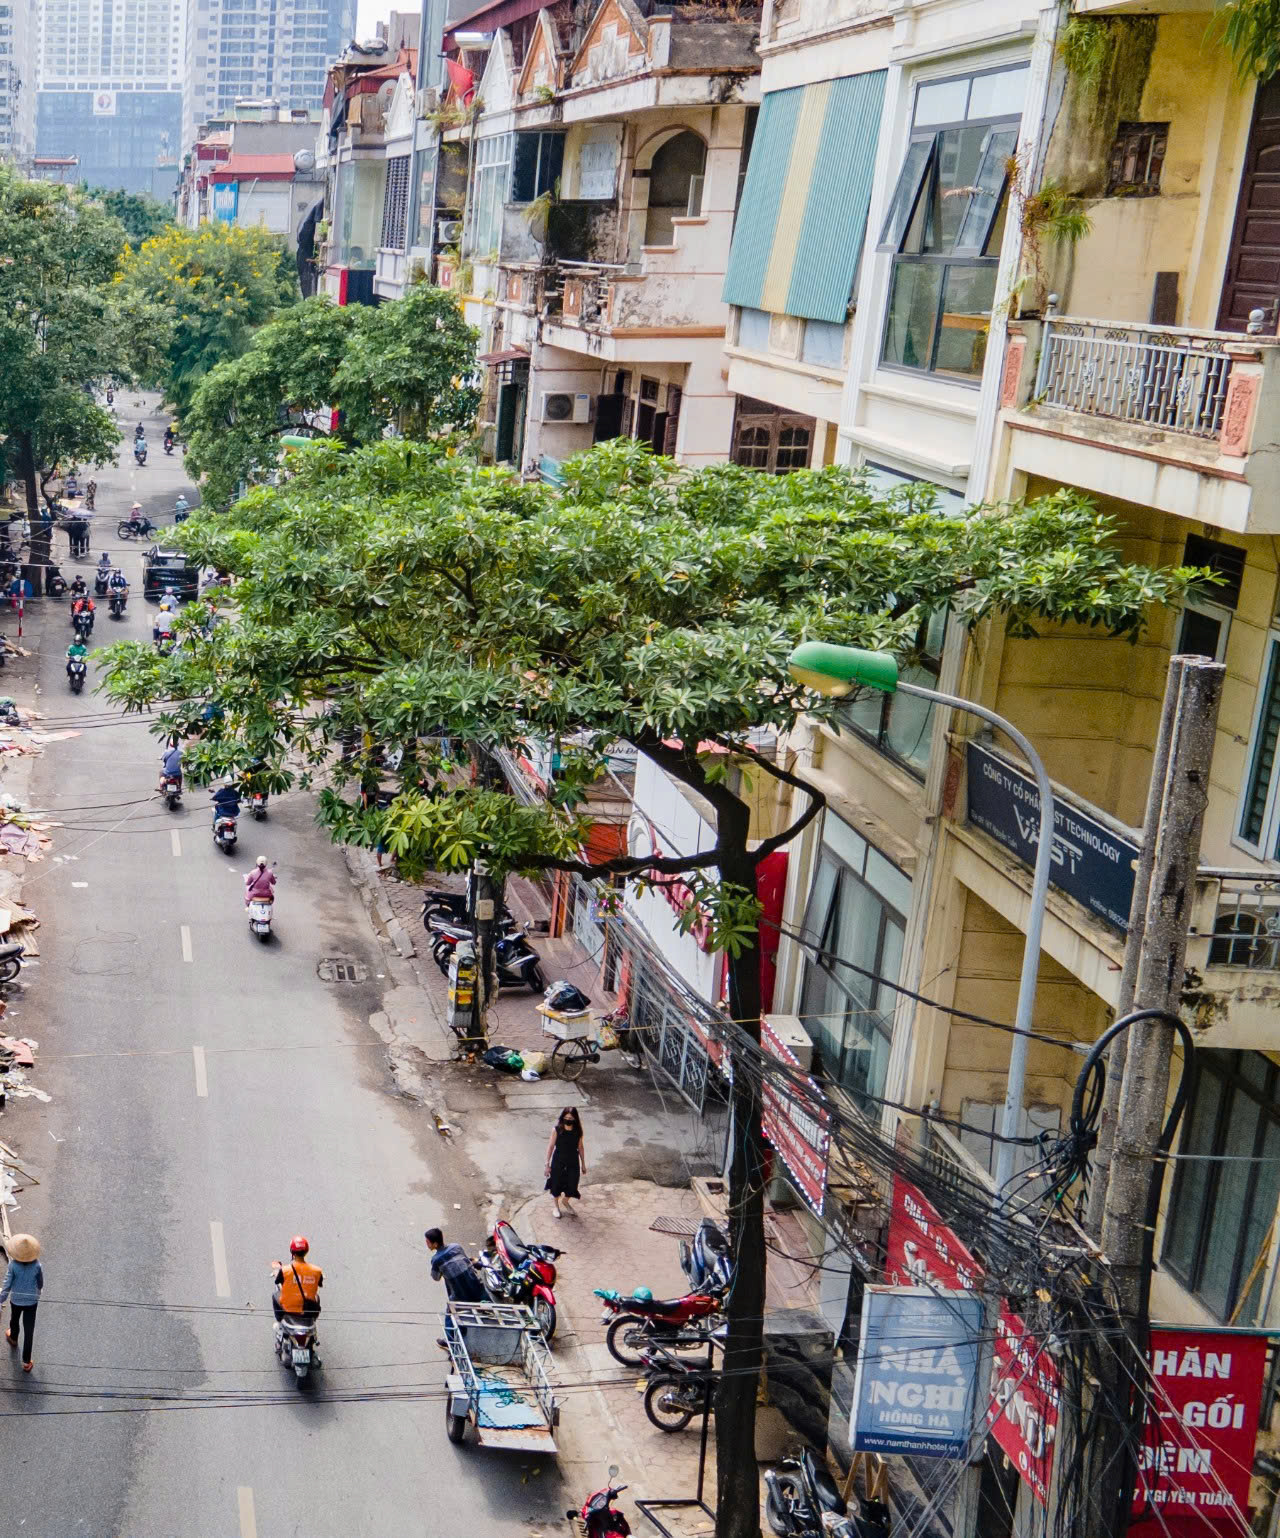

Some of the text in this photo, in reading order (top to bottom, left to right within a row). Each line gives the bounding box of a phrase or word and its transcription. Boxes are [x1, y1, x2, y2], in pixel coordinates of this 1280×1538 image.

[1003, 775, 1012, 792] TY
[1066, 817, 1120, 863] TECHNOLOGY
[1147, 1345, 1231, 1379] HĂN
[867, 1377, 967, 1412] NGHỈ
[1181, 1393, 1245, 1429] GỐI
[863, 1437, 960, 1452] www.namthanhhotel.vn
